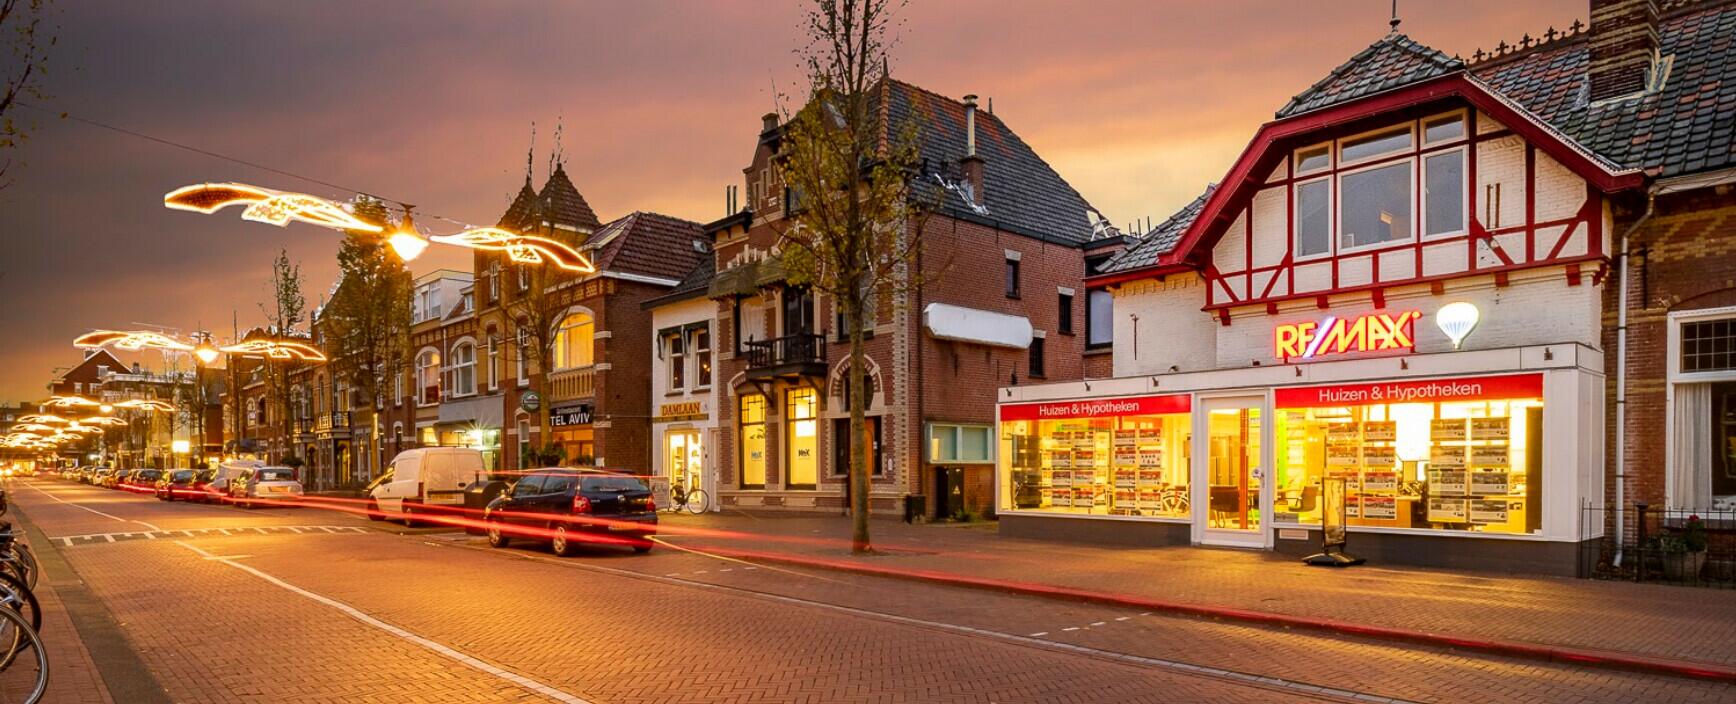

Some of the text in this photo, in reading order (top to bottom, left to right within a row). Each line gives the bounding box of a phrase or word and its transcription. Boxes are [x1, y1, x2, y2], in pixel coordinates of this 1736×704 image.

[1319, 382, 1482, 402] Huizen & Hypotheken
[661, 402, 701, 416] DAMLAAN
[1040, 401, 1140, 416] Huizen & Hypotheken
[550, 412, 590, 426] TEL AVIV
